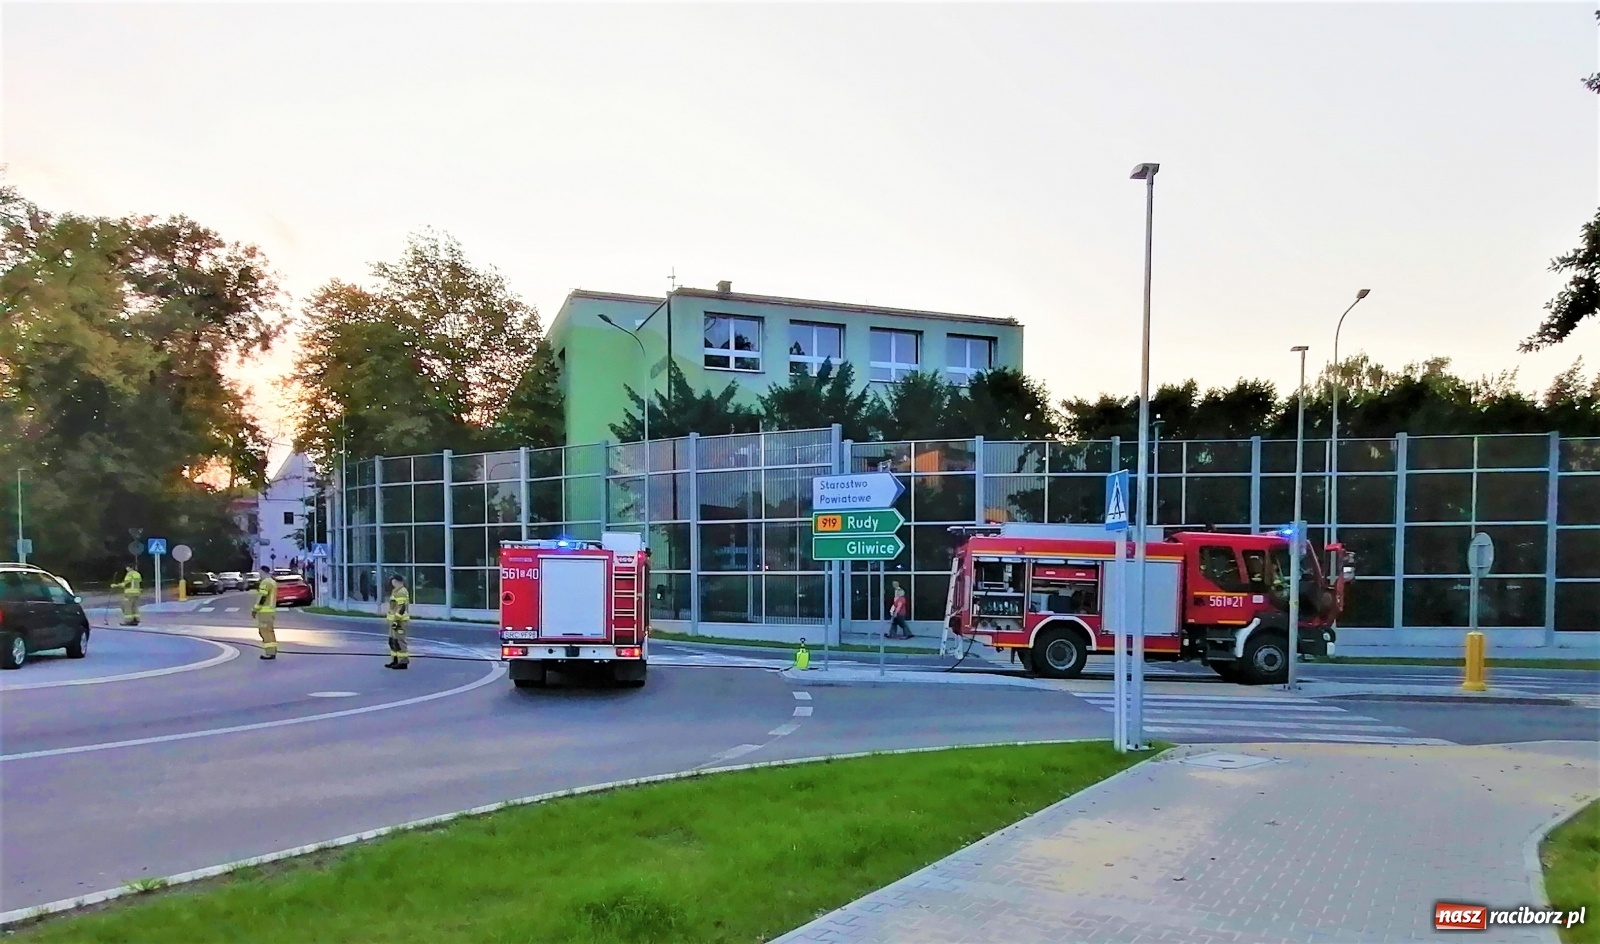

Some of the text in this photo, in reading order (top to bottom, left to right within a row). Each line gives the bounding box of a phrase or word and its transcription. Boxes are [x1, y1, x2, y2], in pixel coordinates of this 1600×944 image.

[820, 480, 868, 490] Starostwo
[820, 494, 871, 504] Powiatowe
[821, 515, 879, 532] 919 Rudy
[846, 541, 895, 554] Gliwice
